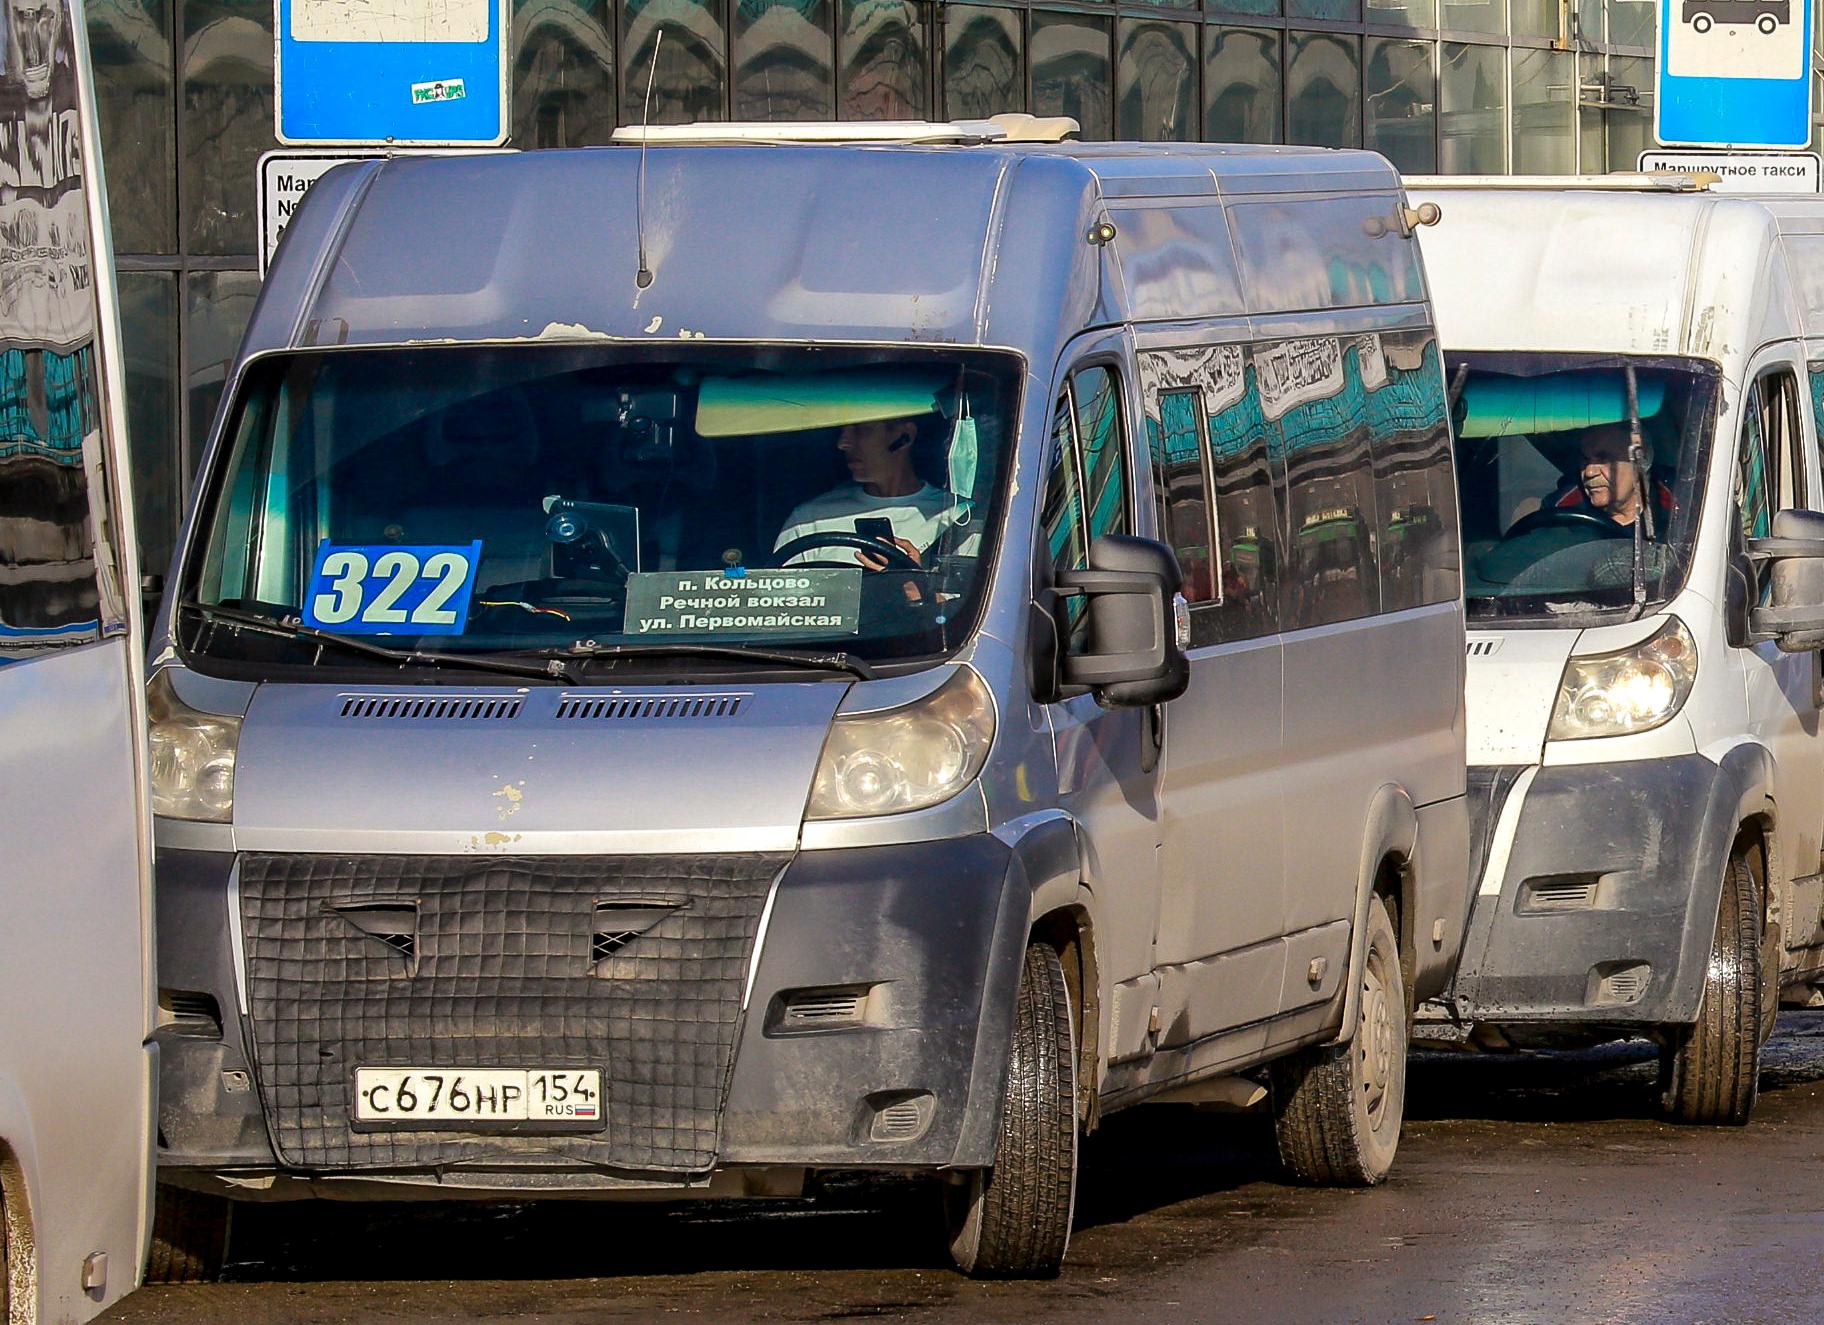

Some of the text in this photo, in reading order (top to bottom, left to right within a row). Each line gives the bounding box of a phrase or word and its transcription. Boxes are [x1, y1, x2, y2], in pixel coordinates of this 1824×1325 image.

[1761, 165, 1806, 176] такси
[313, 551, 469, 624] 322
[678, 576, 811, 591] п. Кольцово
[659, 595, 826, 610] Речной вокзал
[639, 613, 842, 633] ул. Первомайская
[533, 1074, 589, 1102] 154
[545, 1104, 574, 1116] RUS
